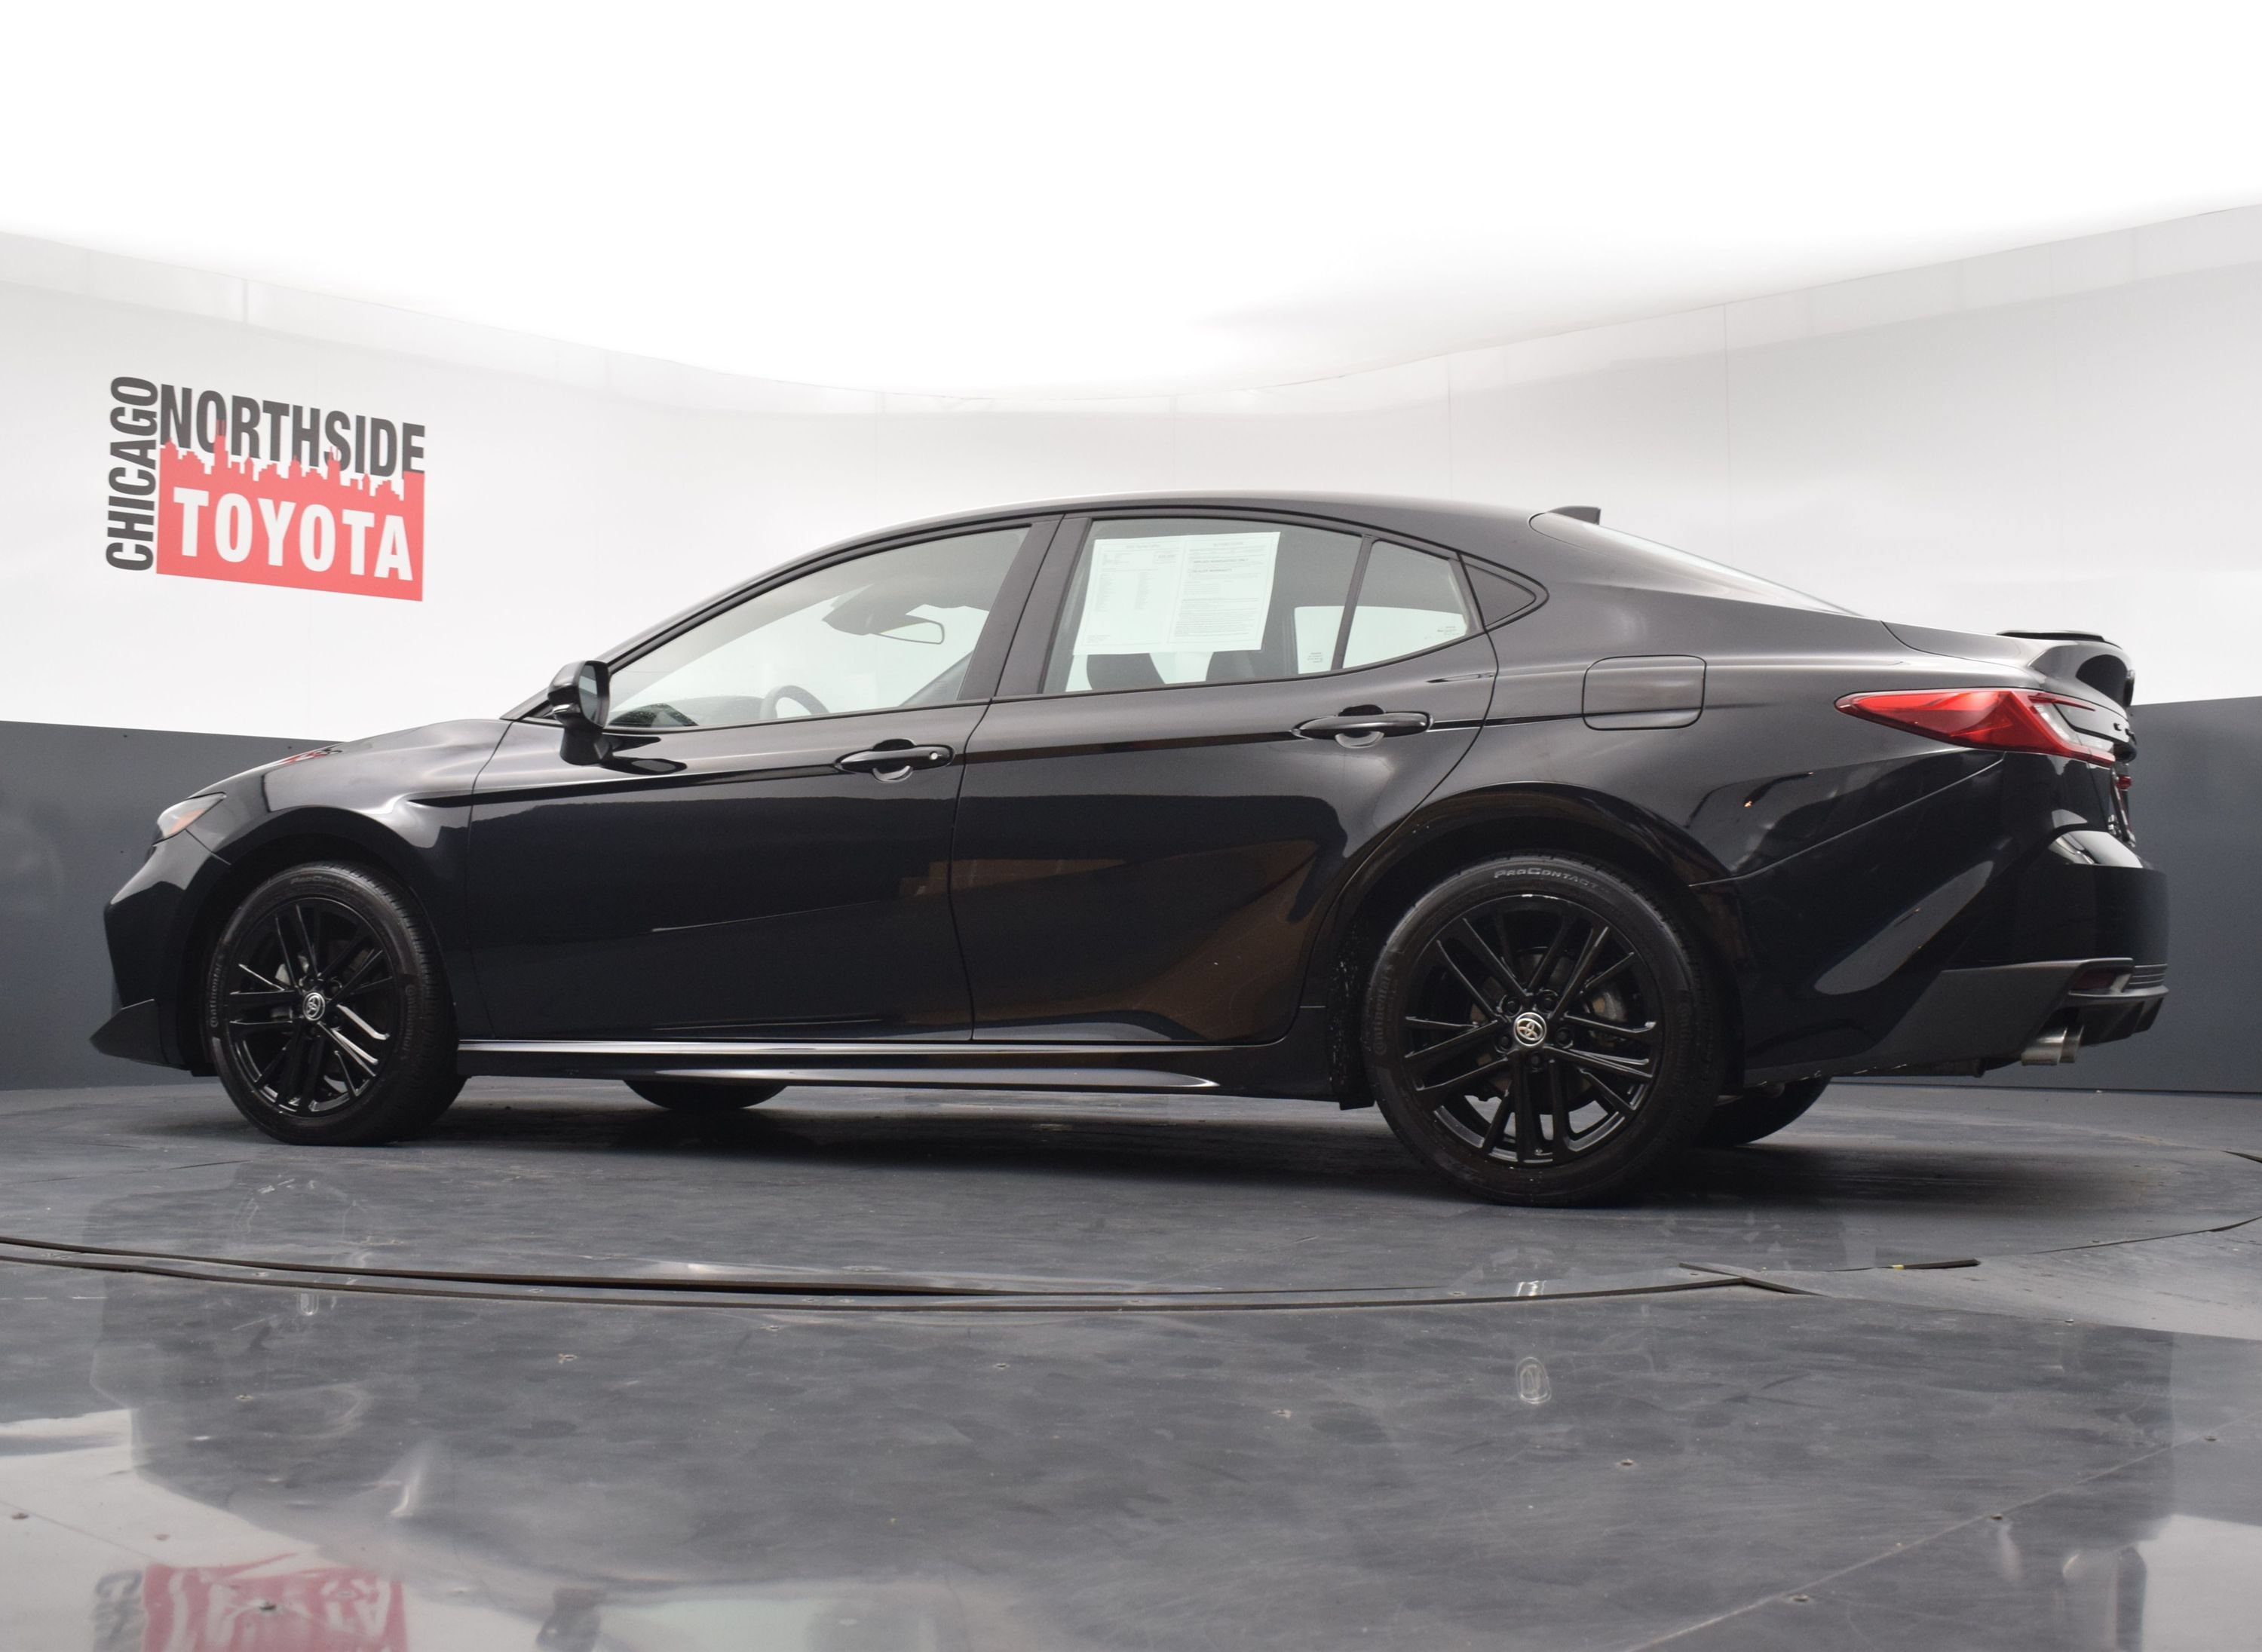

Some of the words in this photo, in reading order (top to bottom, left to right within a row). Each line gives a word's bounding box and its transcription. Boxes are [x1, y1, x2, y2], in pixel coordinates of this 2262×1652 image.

[106, 376, 158, 571] CHICAGO
[160, 384, 425, 478] NORTHSIDE
[173, 487, 413, 581] TOYOTA
